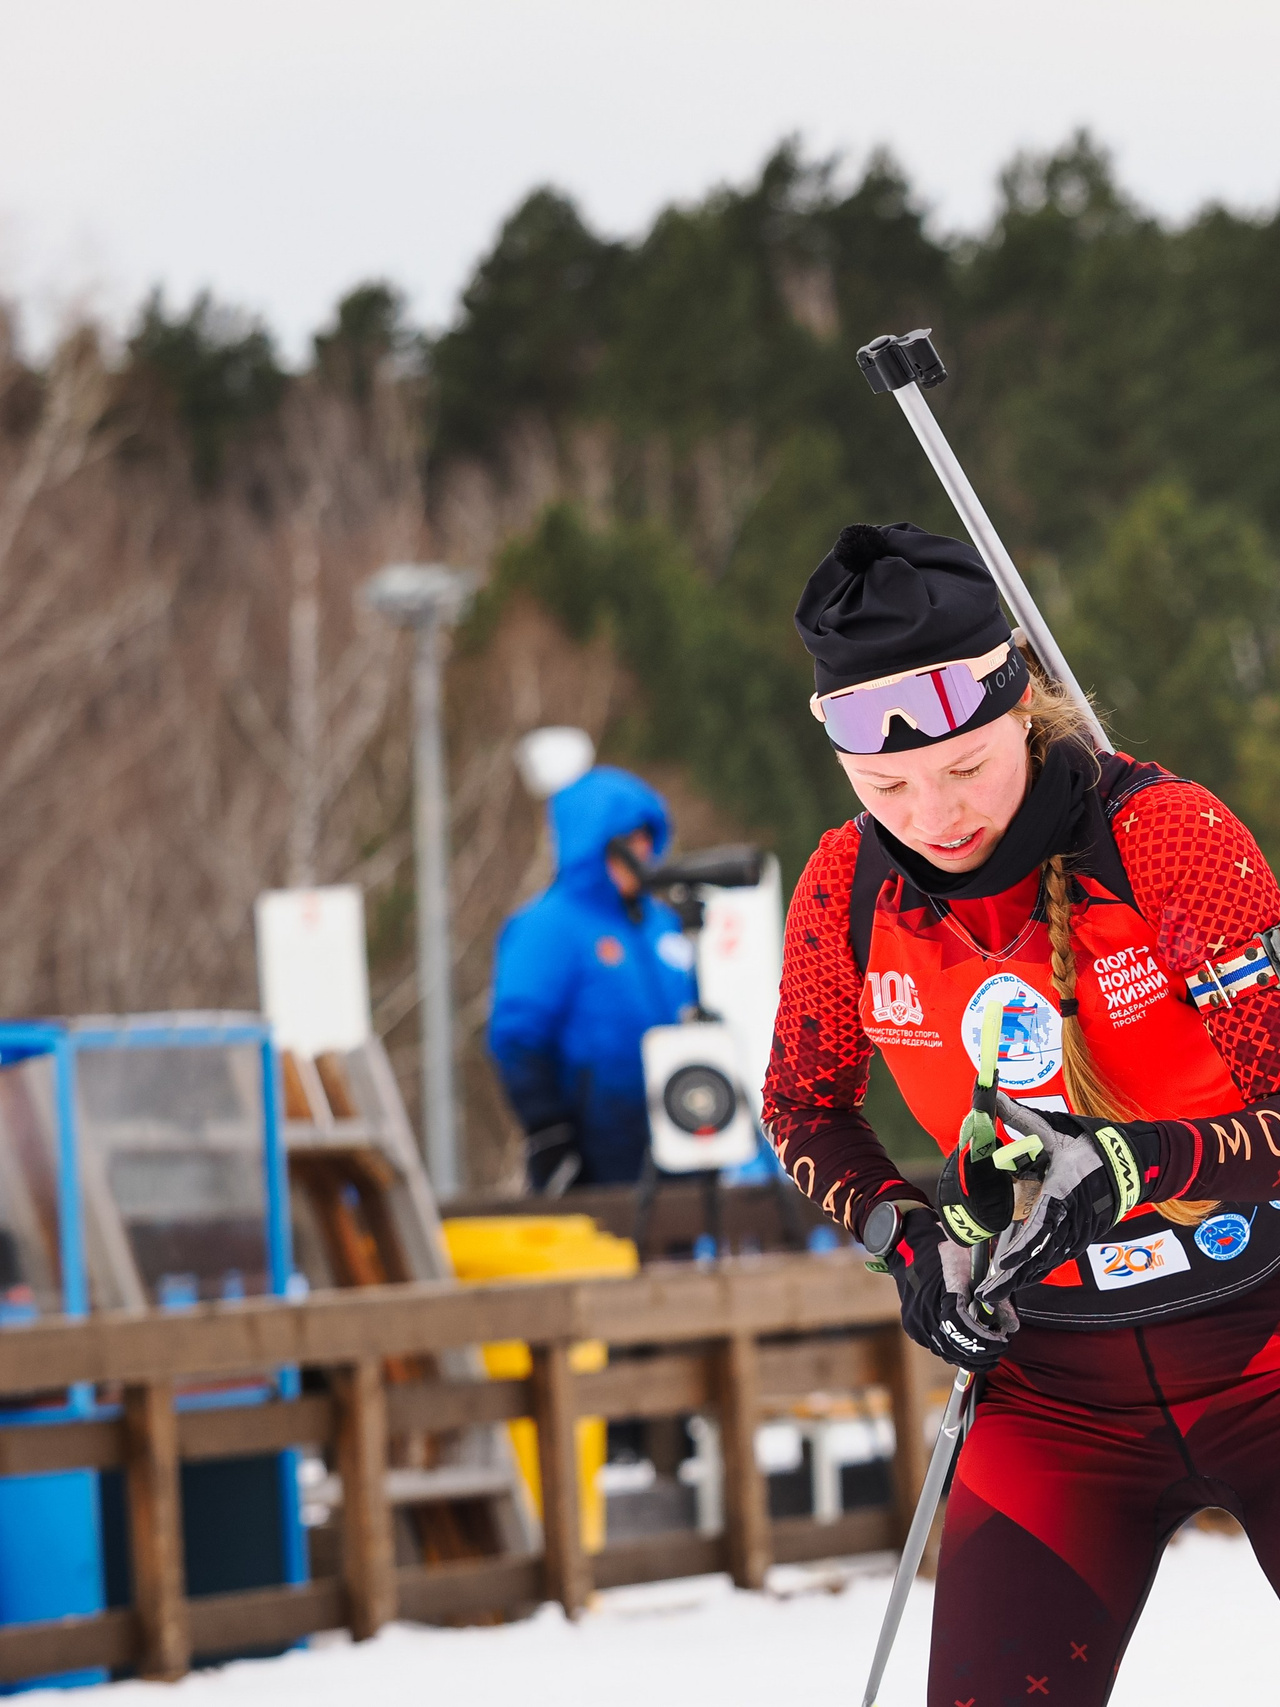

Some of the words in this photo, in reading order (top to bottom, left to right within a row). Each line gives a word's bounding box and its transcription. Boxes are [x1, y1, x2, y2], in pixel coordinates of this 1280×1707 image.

[1097, 956, 1158, 993] НОРМА
[969, 975, 1015, 1011] ПЕРВЕНСТВО
[1103, 971, 1169, 1011] ЖИЗНИ
[1112, 1010, 1147, 1030] ПРОЕКТ
[901, 1038, 943, 1049] ФЕДЕРАЦИИ
[914, 1030, 940, 1039] СПОРТА
[1037, 1060, 1055, 1079] 2023
